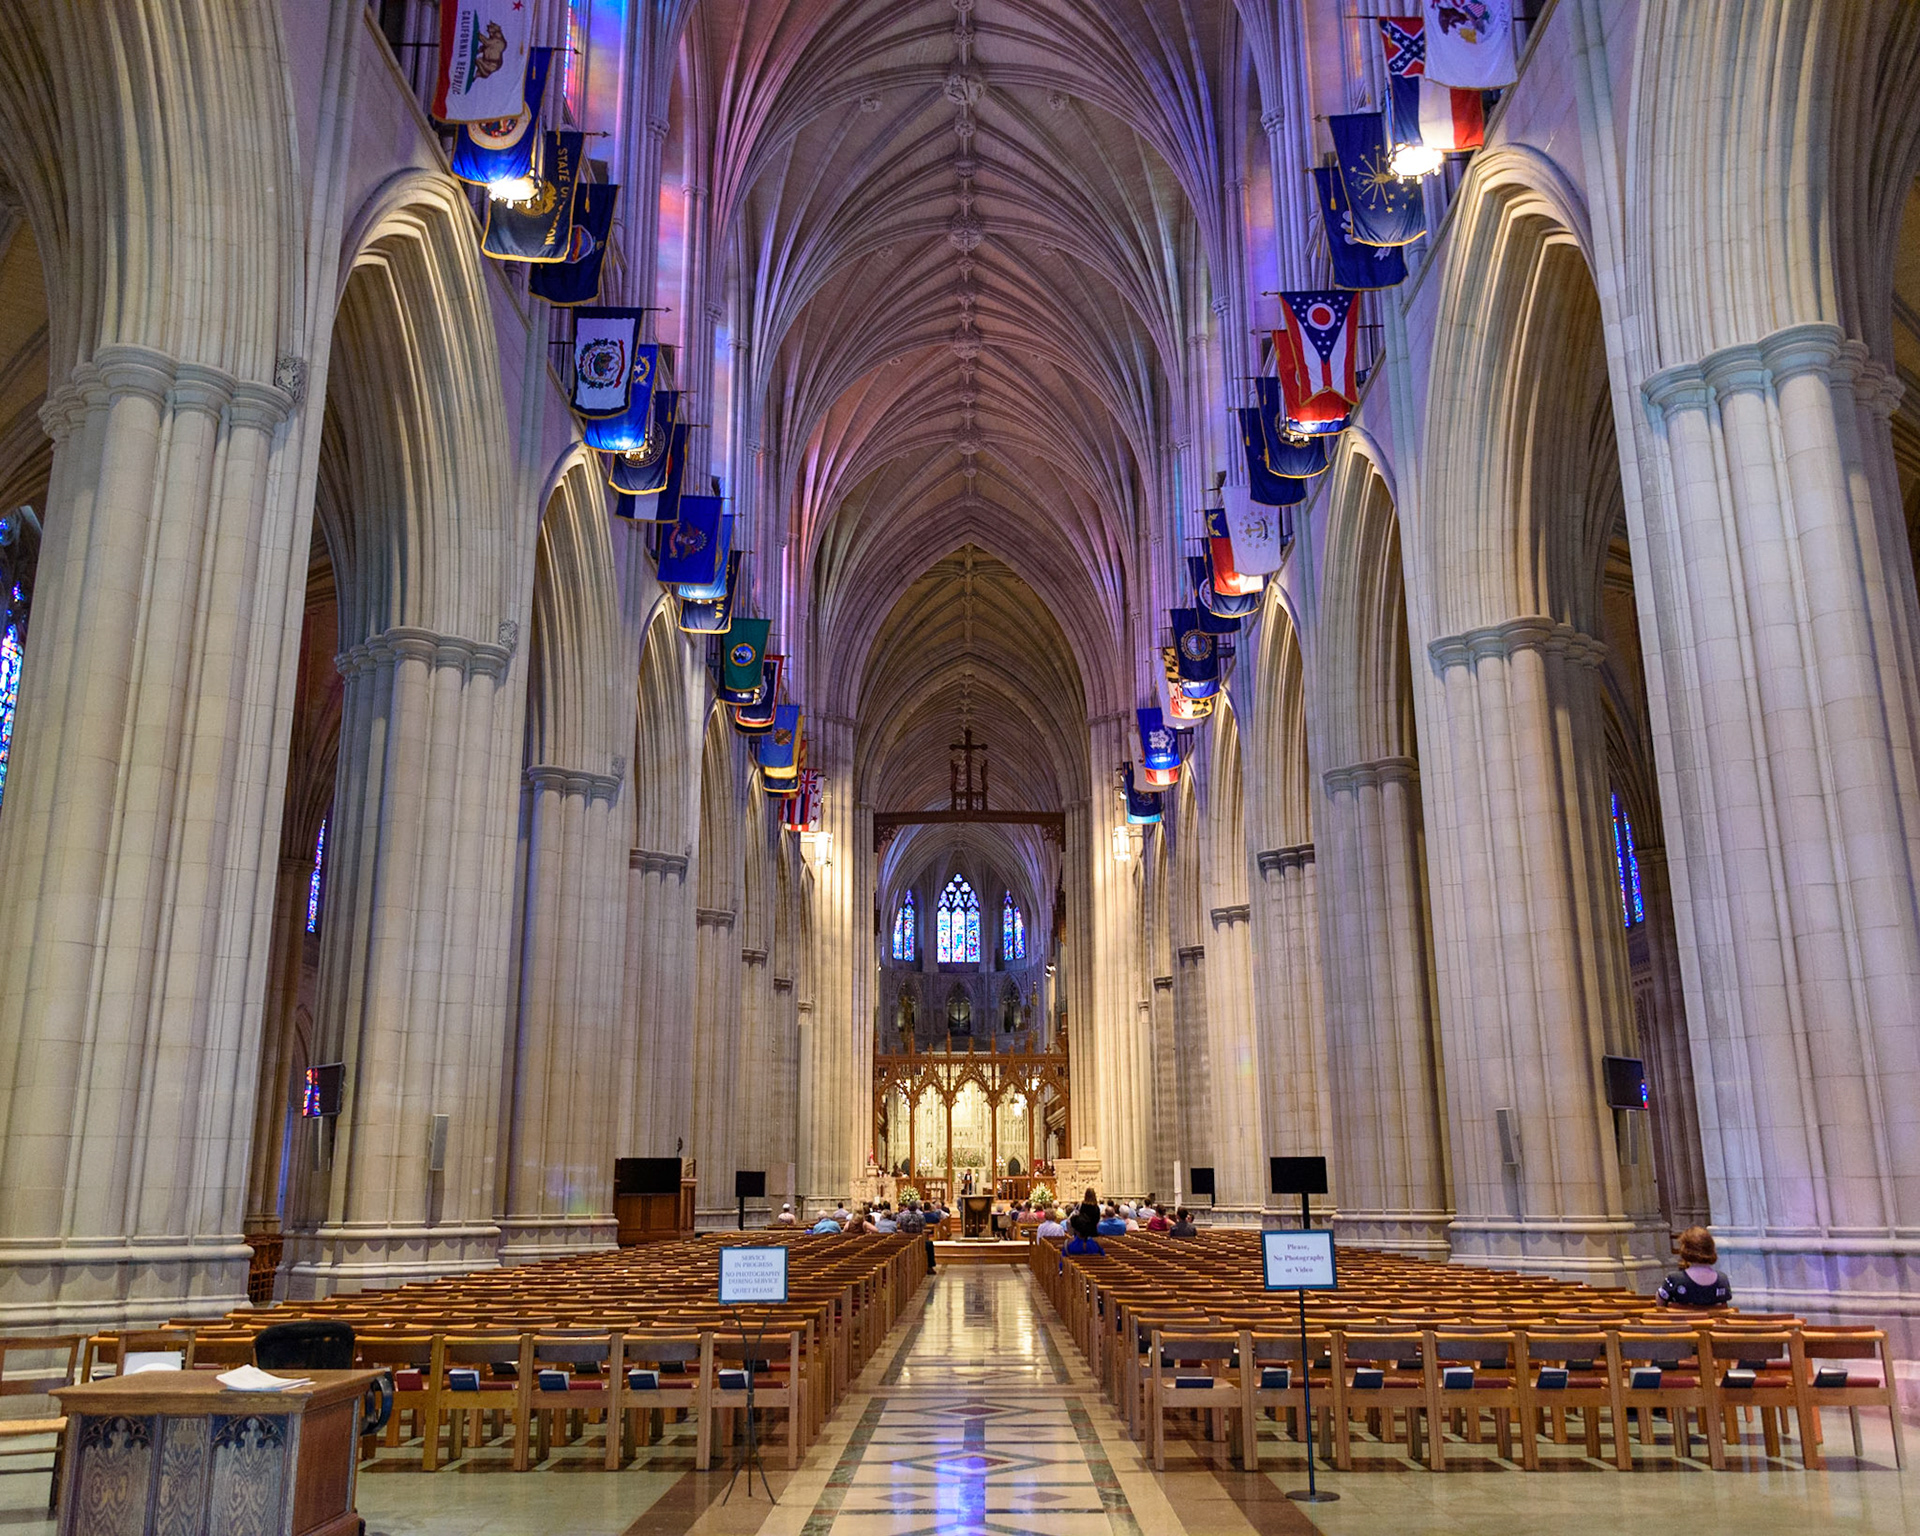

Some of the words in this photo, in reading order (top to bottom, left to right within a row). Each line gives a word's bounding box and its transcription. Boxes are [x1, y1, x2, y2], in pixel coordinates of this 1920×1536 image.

[458, 10, 471, 58] CALIFORNIA
[451, 61, 466, 95] REPUBLIC
[557, 147, 571, 182] STATE
[1284, 1254, 1324, 1262] Photography
